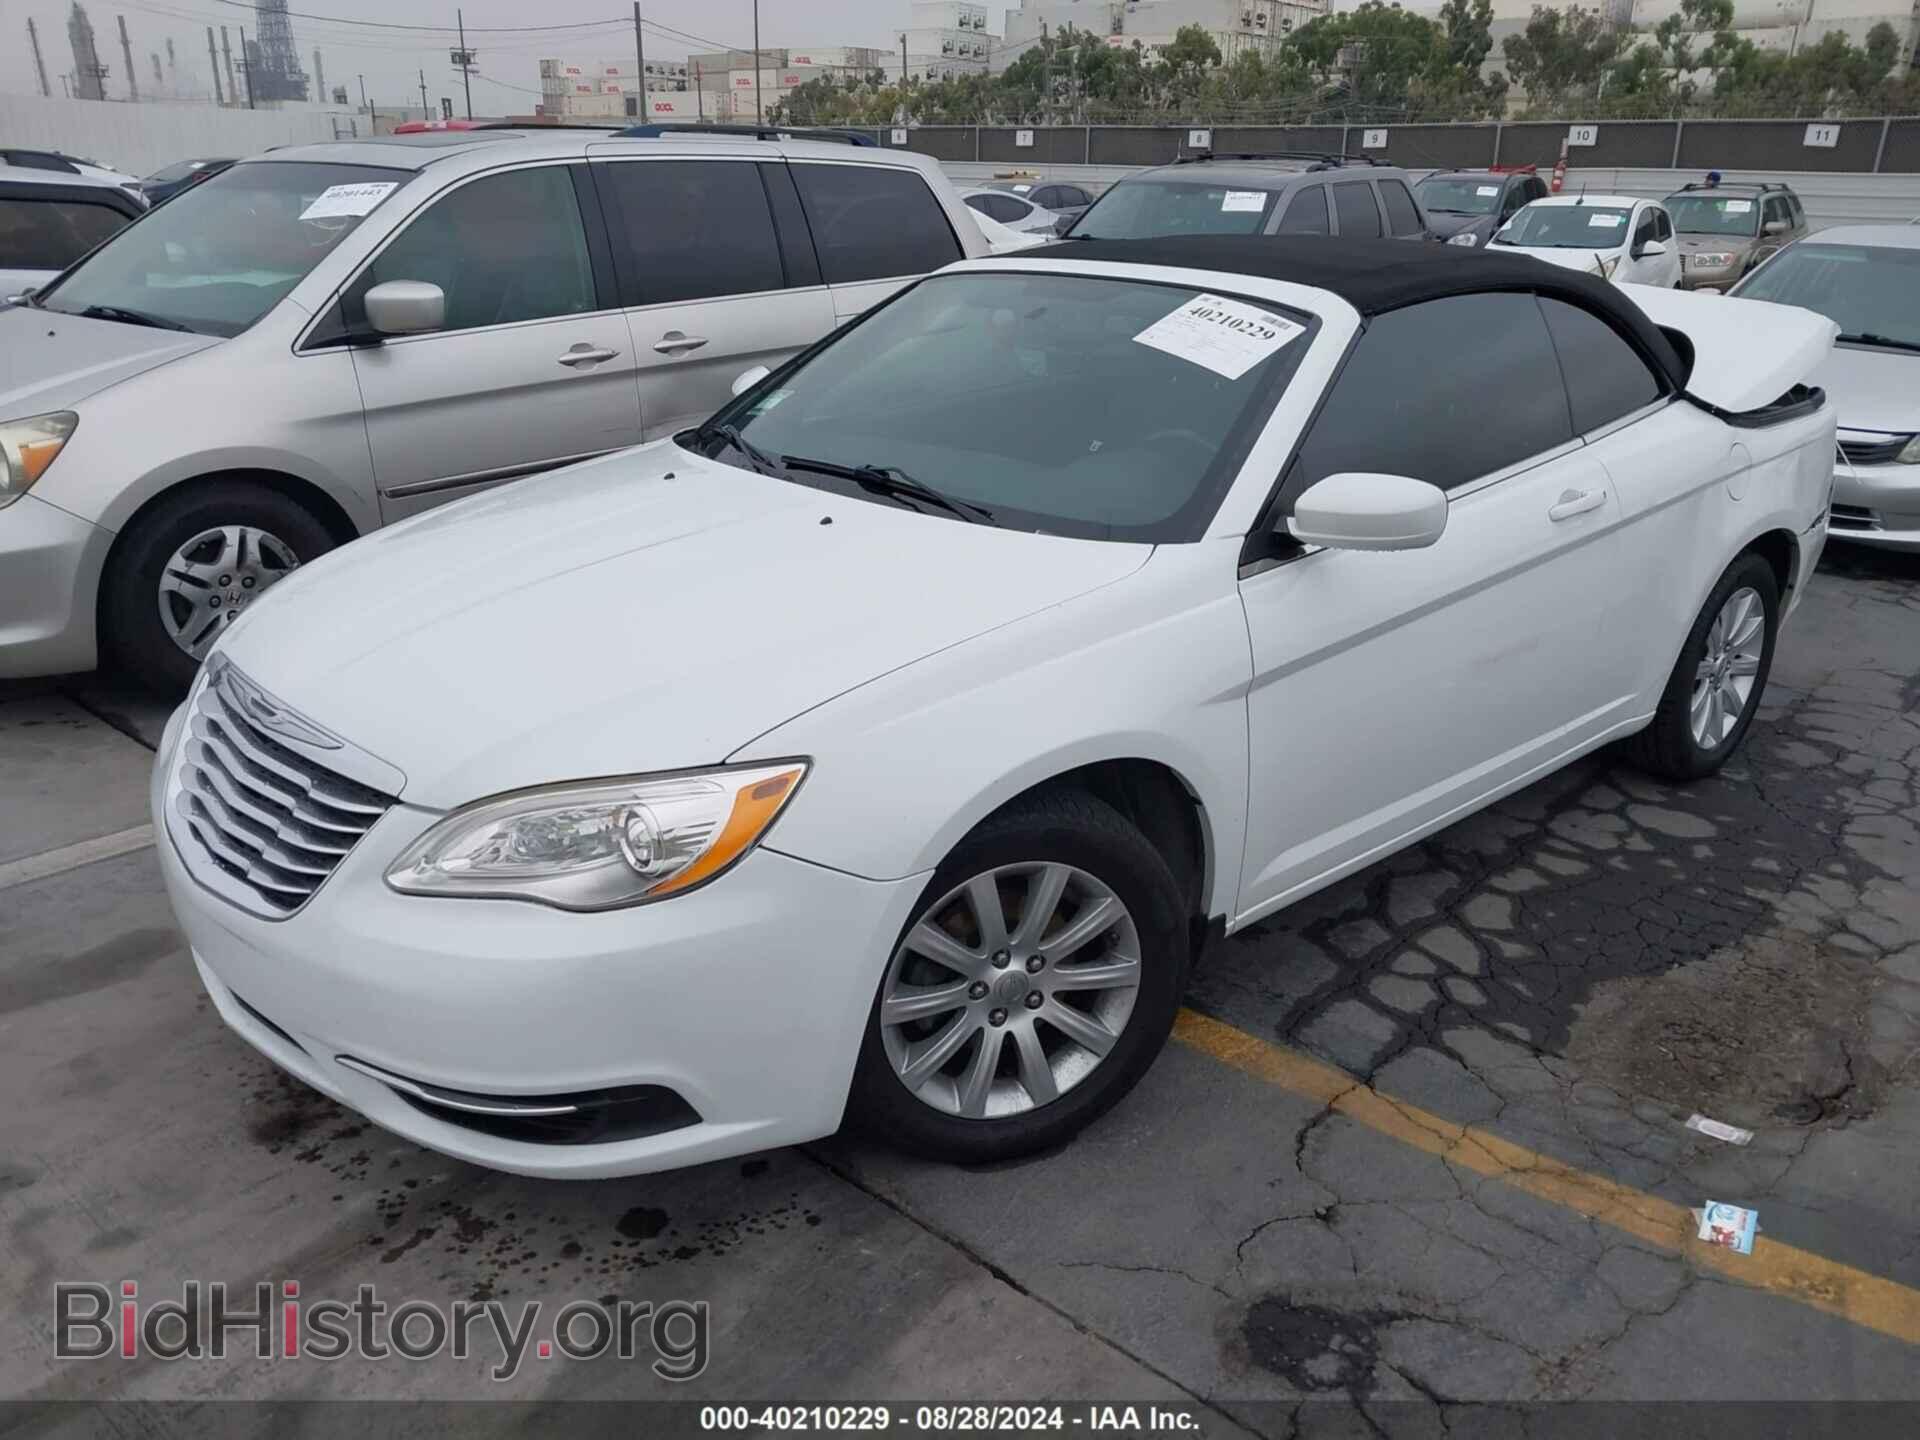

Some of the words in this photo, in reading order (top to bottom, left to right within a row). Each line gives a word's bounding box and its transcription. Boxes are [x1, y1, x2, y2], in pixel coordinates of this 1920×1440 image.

[1372, 134, 1378, 144] 9
[1576, 130, 1590, 141] 10
[1815, 130, 1830, 141] 11
[1188, 305, 1277, 341] 40210229
